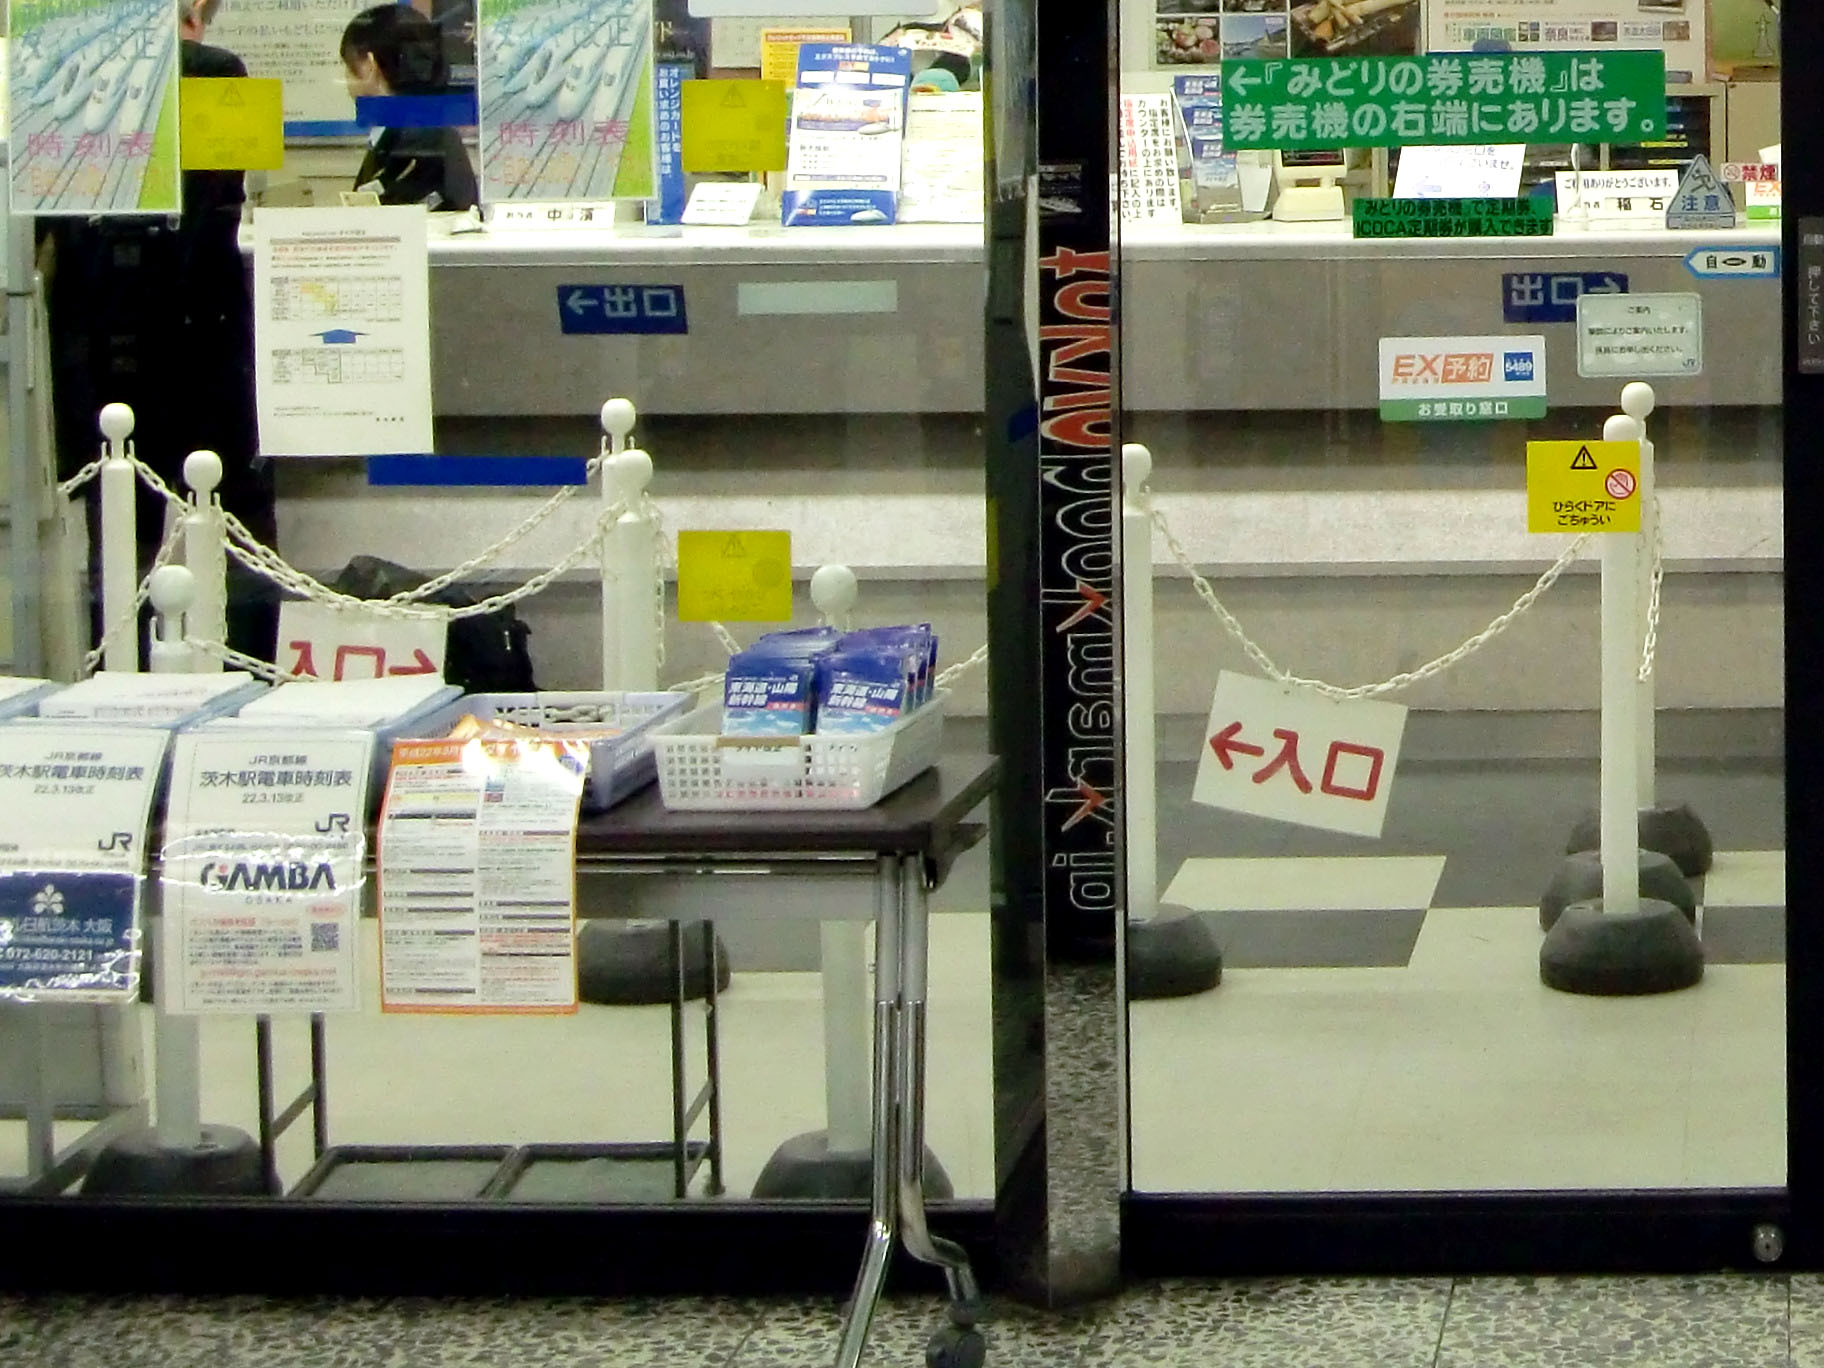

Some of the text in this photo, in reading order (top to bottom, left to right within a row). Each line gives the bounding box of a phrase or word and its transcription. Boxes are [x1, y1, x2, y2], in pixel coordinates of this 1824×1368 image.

[1228, 96, 1656, 141] 券売機の右端にあります。
[499, 120, 631, 147] 時刻表
[1741, 164, 1778, 181] 禁煙
[1681, 195, 1722, 212] 注意
[1511, 274, 1581, 306] 出口
[604, 287, 678, 318] 出口
[1417, 401, 1509, 417] お受取り窓口
[1552, 499, 1616, 513] ひらくドアに
[1251, 726, 1385, 801] 入口
[198, 770, 353, 788] 茨木駅電車時刻表
[315, 813, 351, 833] JR
[98, 832, 133, 851] JR
[199, 861, 337, 893] GAMBA
[244, 895, 294, 905] OSAKA
